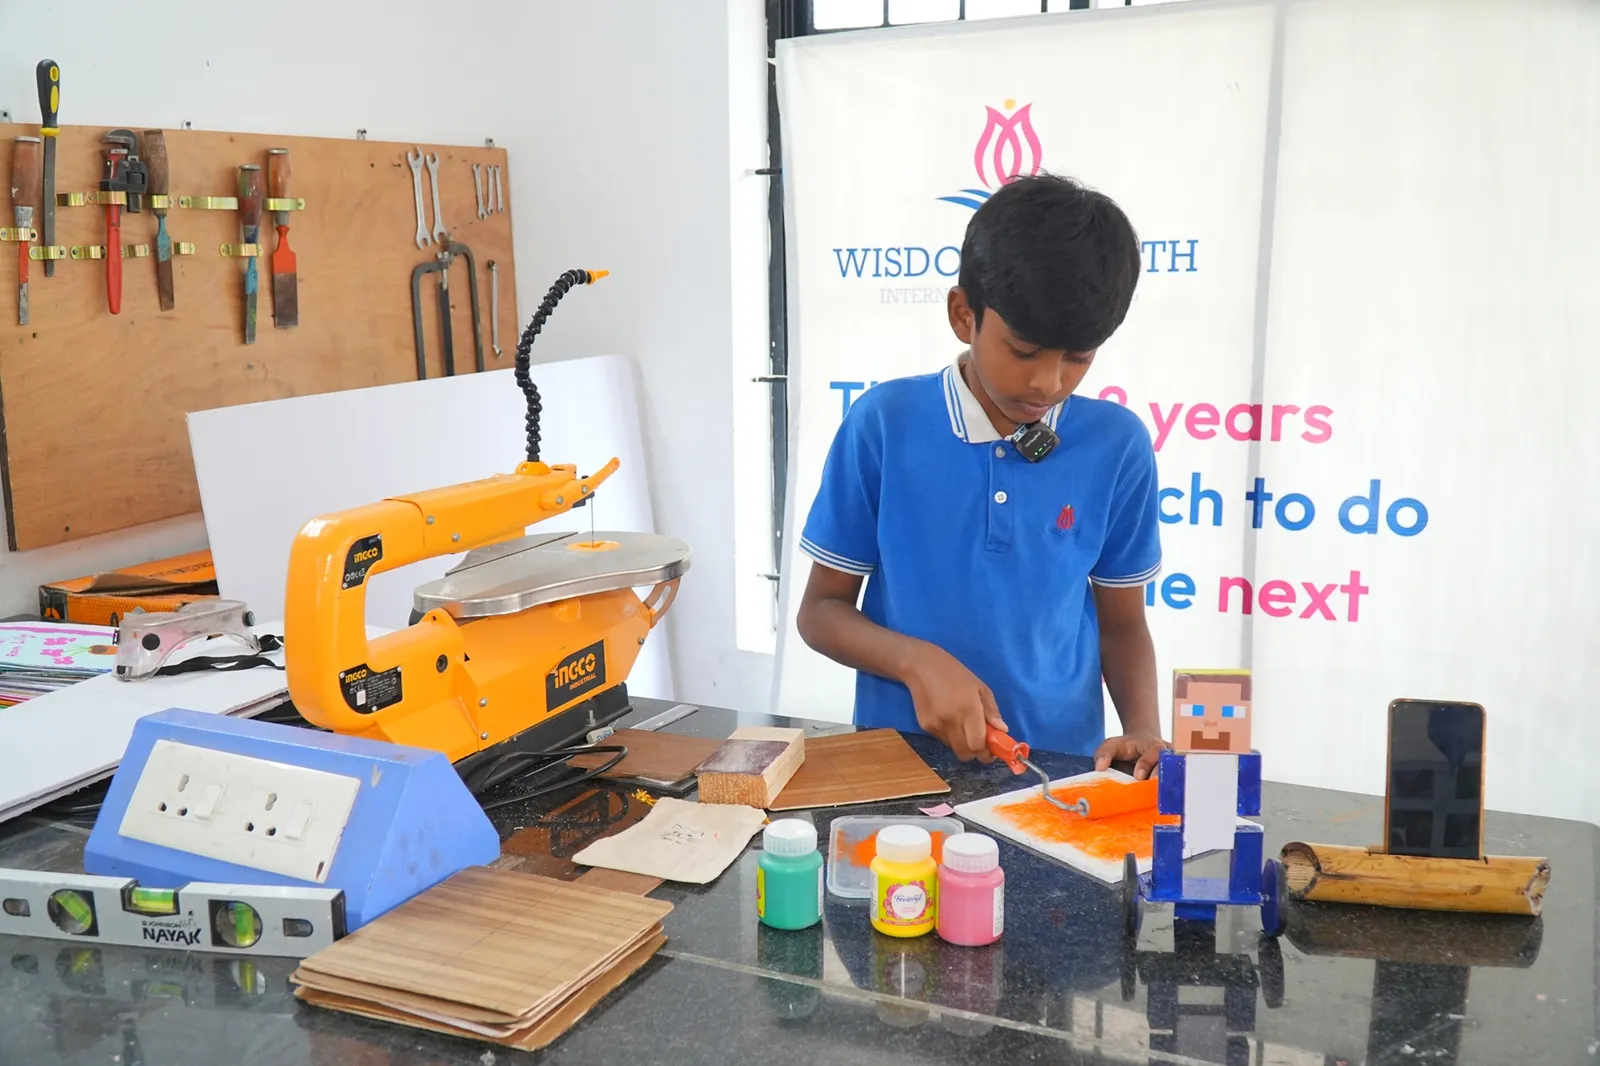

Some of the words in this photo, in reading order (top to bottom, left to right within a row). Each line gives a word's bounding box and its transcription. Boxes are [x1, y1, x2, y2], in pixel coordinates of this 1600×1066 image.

[833, 246, 962, 278] WISDO
[879, 288, 949, 304] INTERN
[1148, 401, 1334, 453] years
[1245, 476, 1316, 532] to
[1337, 478, 1429, 537] do
[1217, 569, 1370, 623] next
[142, 927, 202, 946] NAYAK
